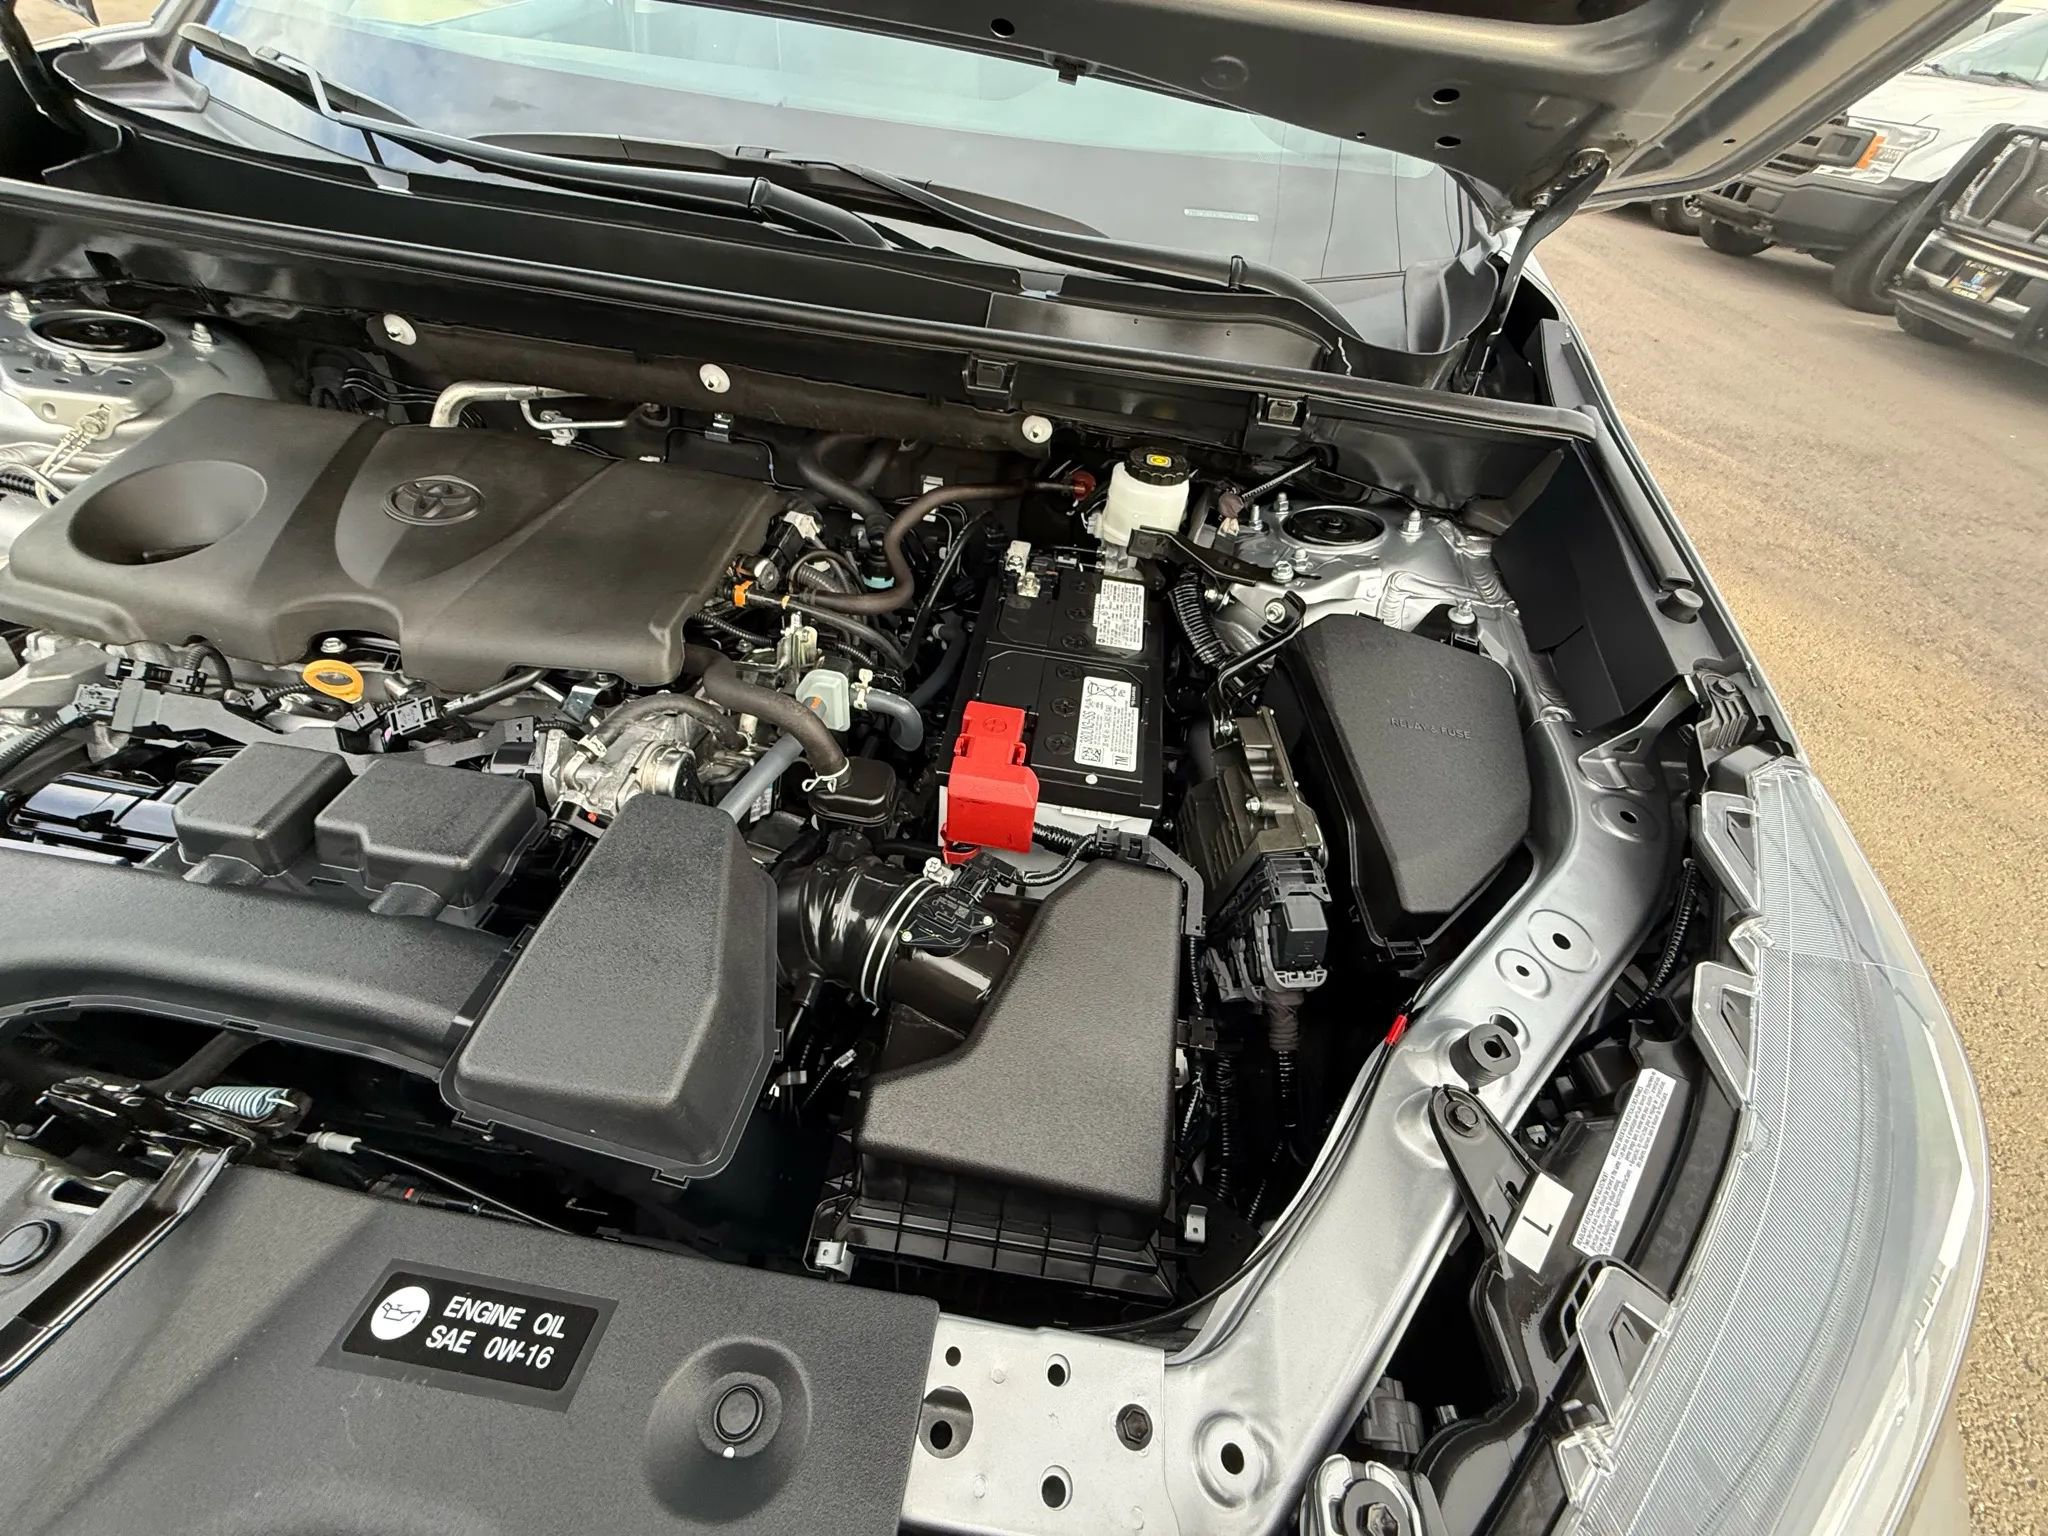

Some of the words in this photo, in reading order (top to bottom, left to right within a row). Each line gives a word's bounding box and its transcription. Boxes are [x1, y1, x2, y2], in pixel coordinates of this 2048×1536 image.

[1390, 718, 1426, 731] RELAY
[1440, 726, 1472, 740] FUSE
[1523, 1215, 1553, 1237] L
[443, 1295, 526, 1330] ENGINE
[533, 1312, 566, 1338] OIL
[425, 1324, 476, 1353] SAE
[483, 1336, 554, 1370] 0W-16
